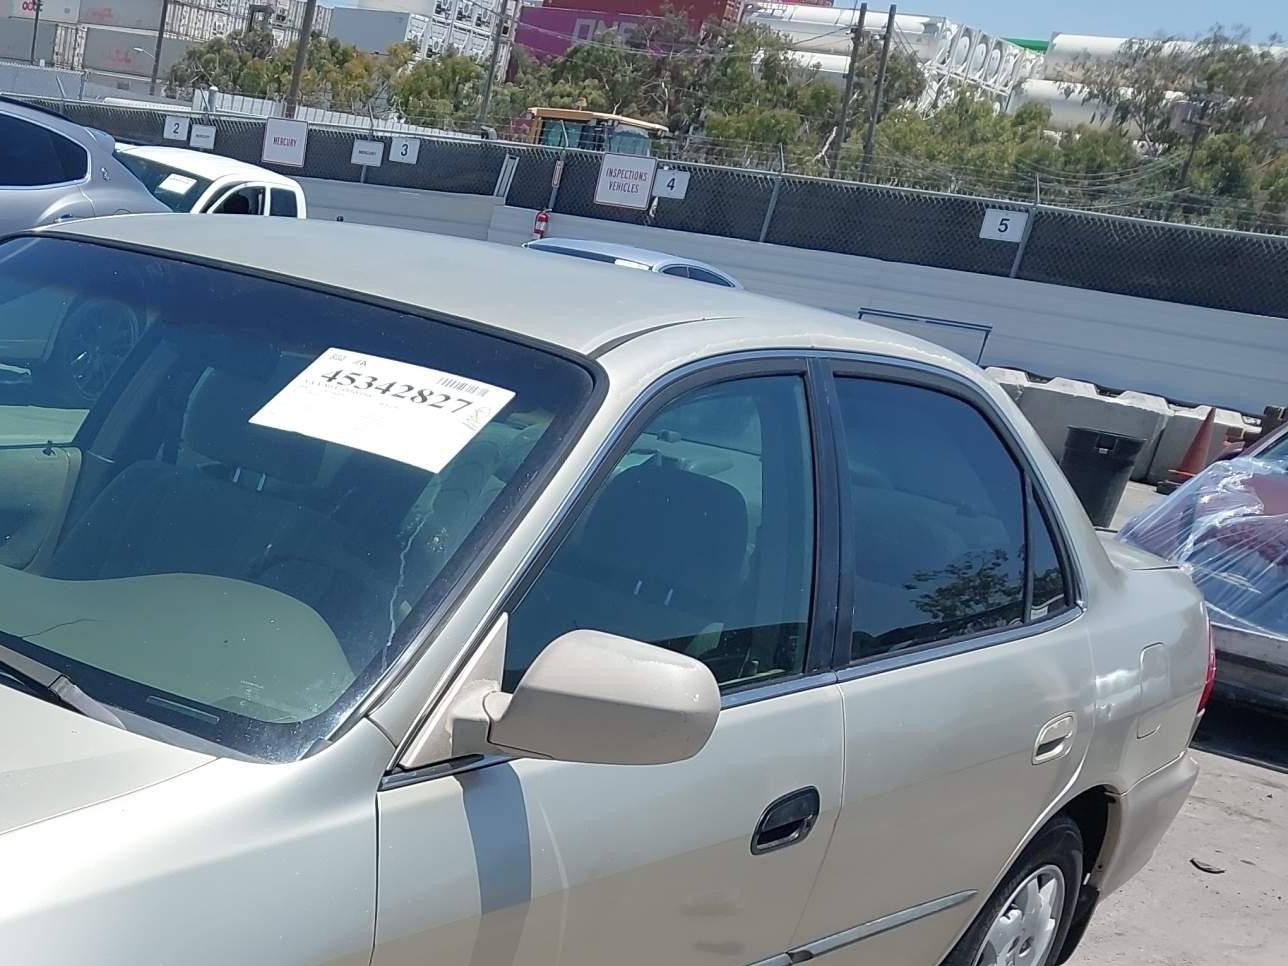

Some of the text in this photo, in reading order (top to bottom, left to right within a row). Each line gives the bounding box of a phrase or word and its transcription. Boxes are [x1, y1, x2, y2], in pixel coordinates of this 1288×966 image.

[172, 122, 180, 134] 2
[273, 136, 297, 148] MERCURY
[400, 143, 409, 156] 3
[605, 167, 648, 181] INSPECTIONS
[608, 180, 640, 194] VEHICLES
[666, 177, 676, 191] 4
[997, 217, 1010, 233] 5
[320, 369, 473, 415] 45342827
